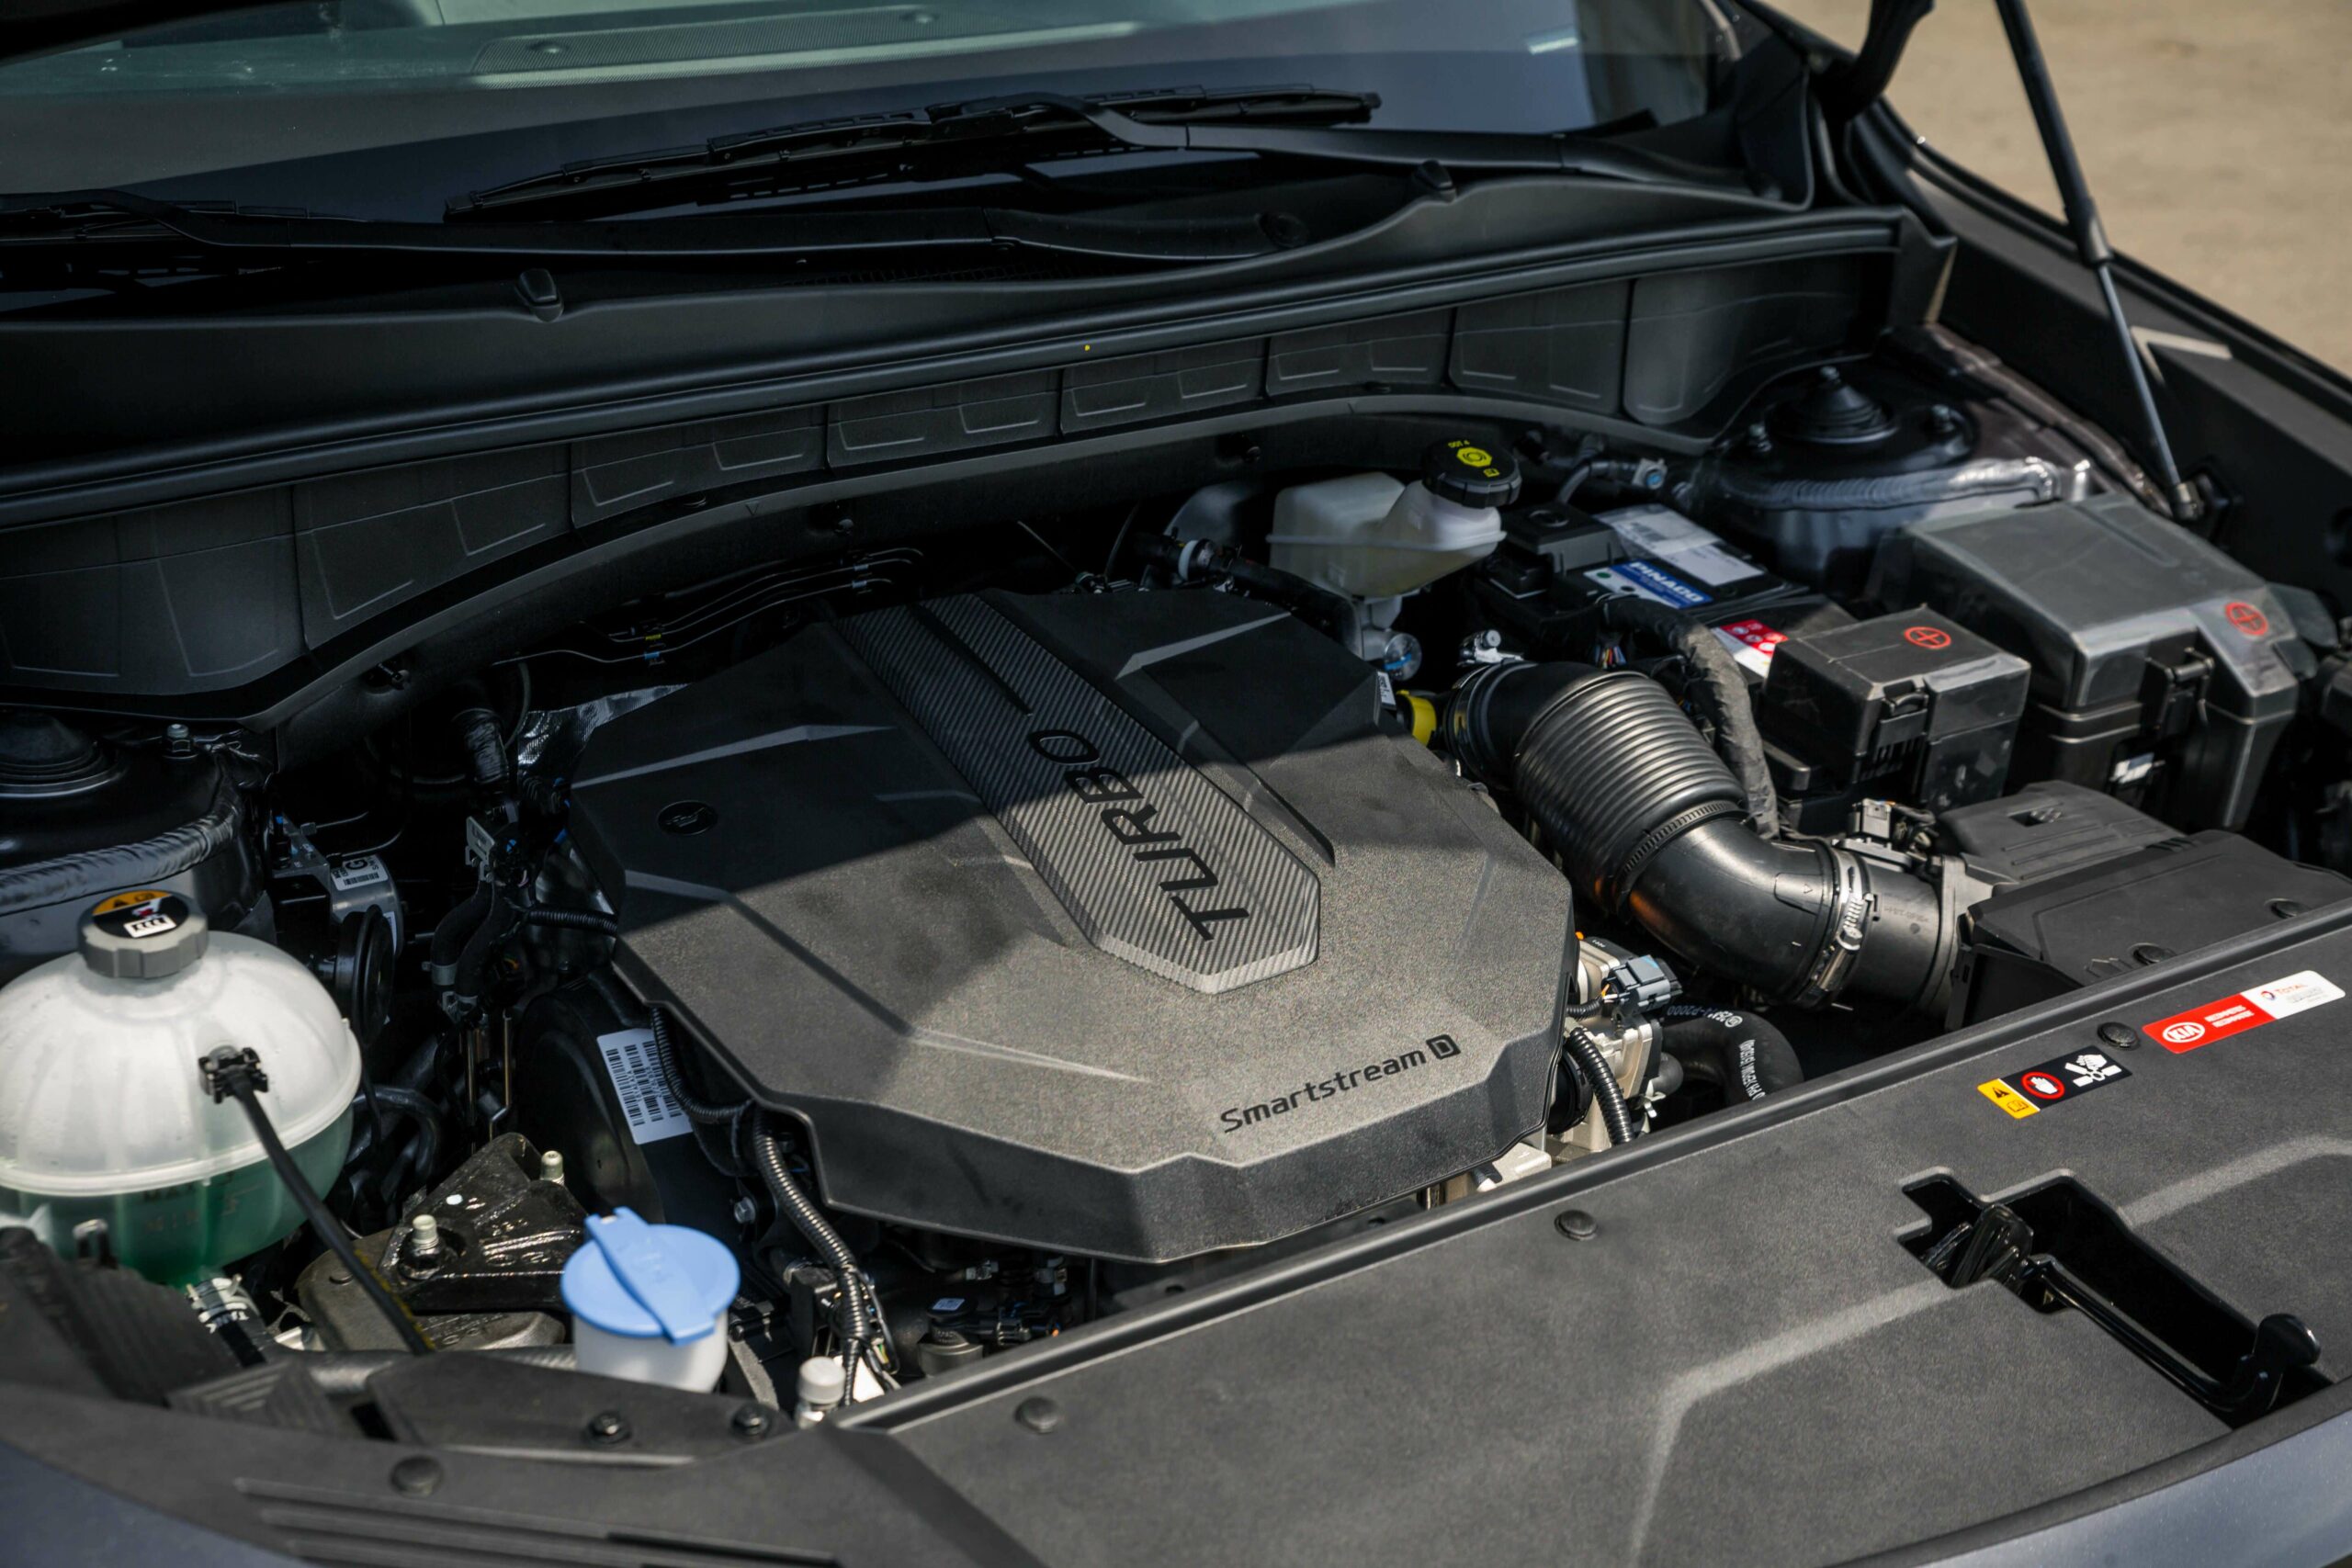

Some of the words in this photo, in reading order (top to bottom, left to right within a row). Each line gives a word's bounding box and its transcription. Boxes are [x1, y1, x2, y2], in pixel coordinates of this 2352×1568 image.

[1032, 730, 1250, 941] TURBO
[1220, 1051, 1427, 1133] Smartstream
[1426, 1034, 1461, 1059] D
